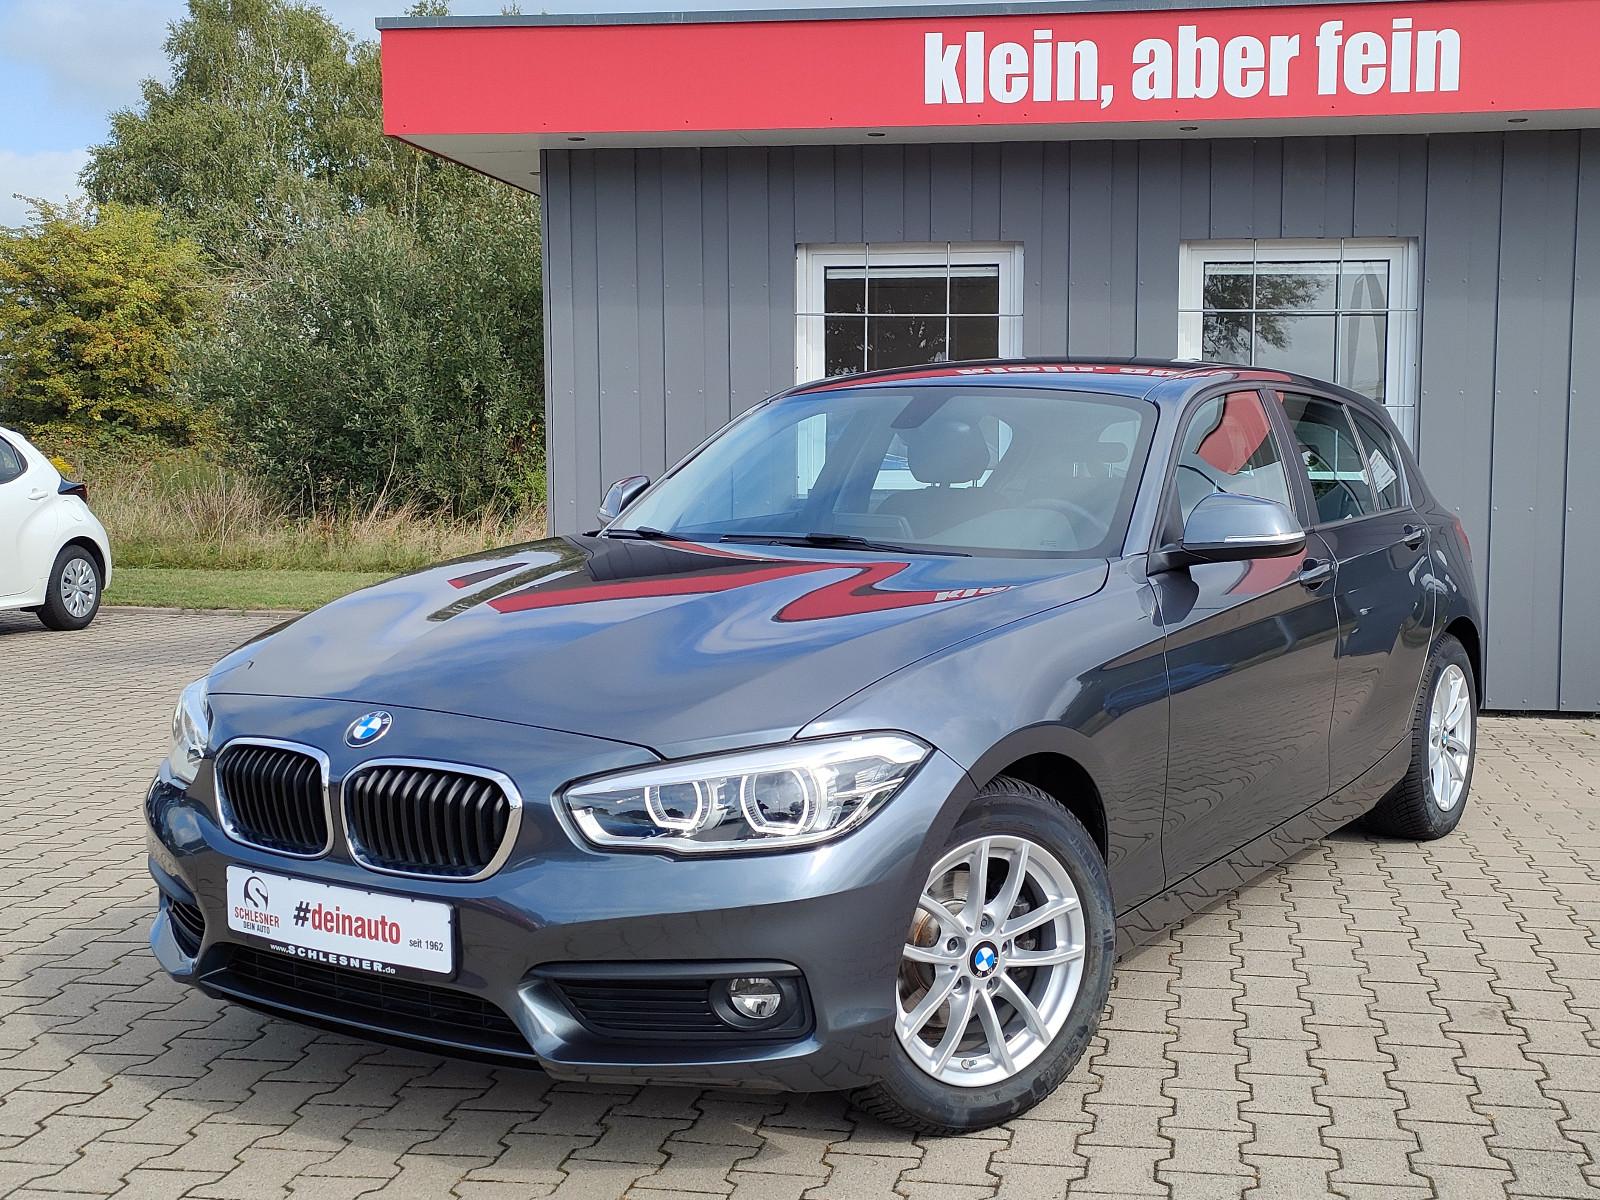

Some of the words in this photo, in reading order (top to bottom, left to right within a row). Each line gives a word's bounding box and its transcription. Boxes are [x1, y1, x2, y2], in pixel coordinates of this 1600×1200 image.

[924, 28, 1113, 110] klein,
[1131, 25, 1300, 101] aber
[1316, 17, 1462, 96] fein
[234, 906, 280, 929] SCHLESNER
[243, 920, 256, 932] DEIN
[257, 924, 271, 935] AUTO
[293, 900, 401, 945] #deinauto
[409, 938, 423, 949] seit
[425, 940, 444, 952] 1962
